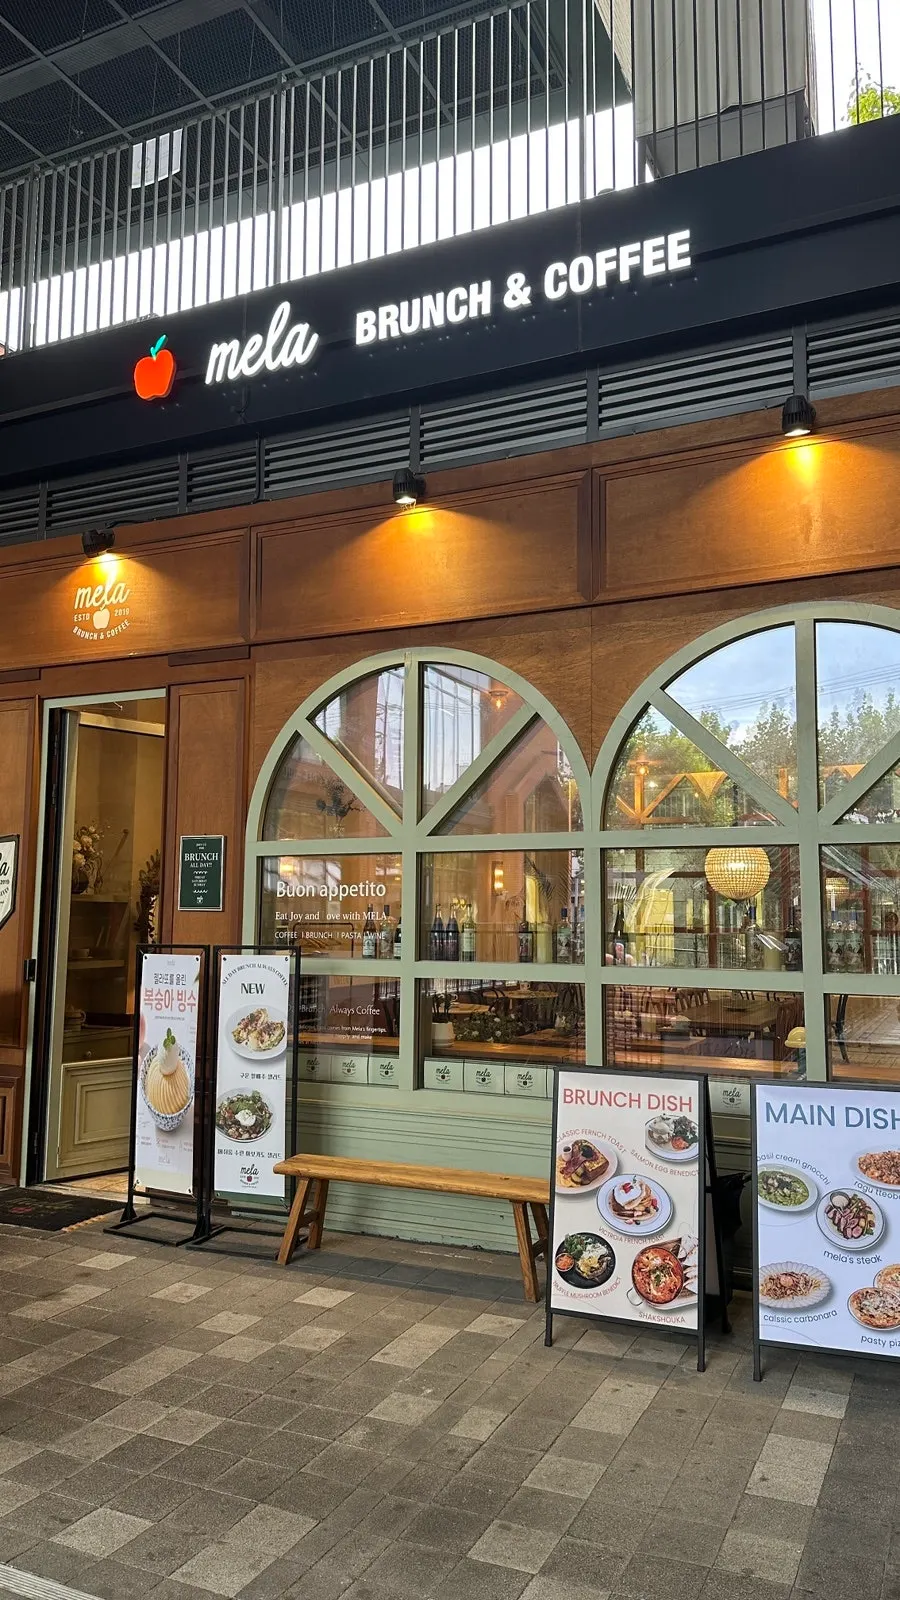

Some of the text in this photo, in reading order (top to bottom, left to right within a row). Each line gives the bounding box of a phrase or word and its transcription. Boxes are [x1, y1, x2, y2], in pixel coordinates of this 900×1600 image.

[204, 229, 691, 386] mela BRUNCH & COFFEE
[74, 574, 131, 609] mela
[73, 607, 130, 622] ESTD 2019
[72, 618, 131, 640] BRUNCH & COFFEE
[184, 852, 219, 861] BRUNCH
[276, 880, 387, 901] Buon appetito
[275, 911, 387, 922] Eat Joy and ove with MELA
[274, 931, 298, 939] COFFEE
[305, 931, 333, 939] BRUNCH
[341, 931, 362, 940] PASTA
[175, 973, 187, 986] 올린
[240, 982, 266, 995] NEW
[143, 988, 197, 1013] 복숭아 빙수
[329, 1004, 355, 1016] Always
[355, 1004, 381, 1015] Coffee
[342, 1059, 356, 1068] mela
[380, 1061, 394, 1070] mela
[435, 1065, 451, 1075] mela
[475, 1068, 491, 1077] mela
[516, 1070, 533, 1080] mela
[722, 1087, 742, 1097] mela
[563, 1088, 692, 1113] BRUNCH DISH
[765, 1101, 836, 1127] MAIN
[580, 1128, 607, 1139] FERNCH
[607, 1135, 627, 1154] TOAST
[630, 1149, 655, 1170] SALMON
[654, 1164, 669, 1174] EGG
[240, 1163, 260, 1176] mela
[775, 1153, 801, 1165] cream
[801, 1160, 831, 1186] gnocchi
[853, 1180, 900, 1201] ragu tteob
[823, 1249, 883, 1265] mela's steak
[570, 1291, 602, 1299] MUSHROOM
[638, 1311, 687, 1324] SHAKSHOUKA
[763, 1309, 838, 1325] calssic carbonara
[860, 1335, 887, 1348] pasty
